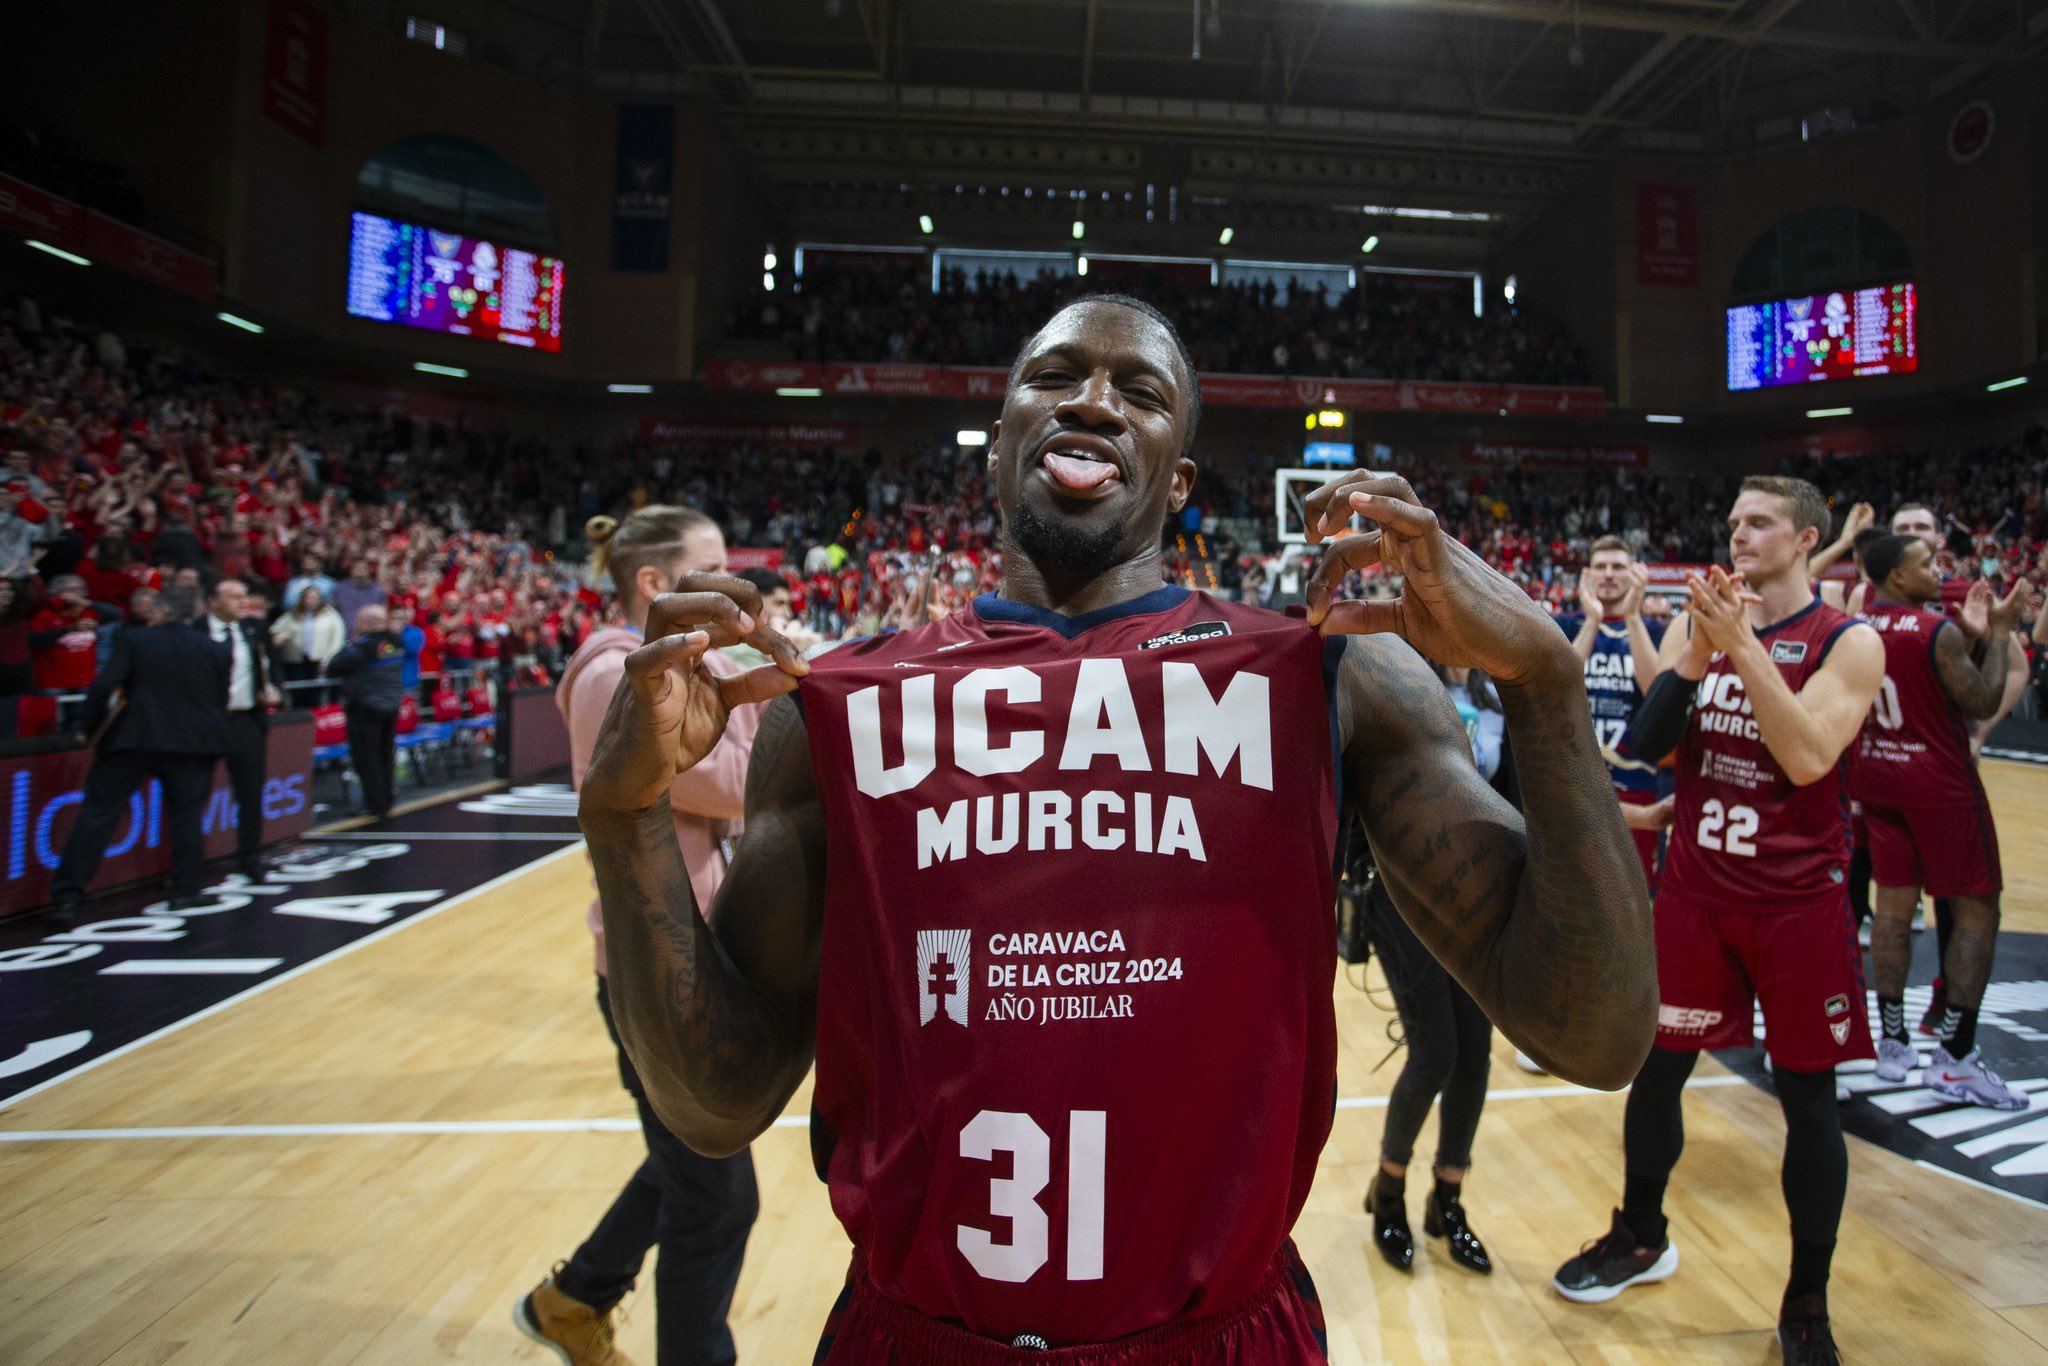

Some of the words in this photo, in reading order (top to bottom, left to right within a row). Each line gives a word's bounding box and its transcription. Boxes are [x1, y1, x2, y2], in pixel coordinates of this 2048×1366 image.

[1148, 630, 1224, 649] endesa
[846, 658, 1273, 799] UCAM
[917, 790, 1207, 870] MURCIA
[1697, 797, 1760, 858] 22
[988, 930, 1126, 955] CARAVACA
[987, 965, 1019, 988] DE
[1022, 963, 1051, 987] LA
[1055, 960, 1121, 986] CRUZ
[1125, 957, 1184, 984] 2024
[984, 993, 1035, 1022] AÑO
[1040, 994, 1134, 1026] JUBILAR
[956, 1109, 1107, 1283] 31
